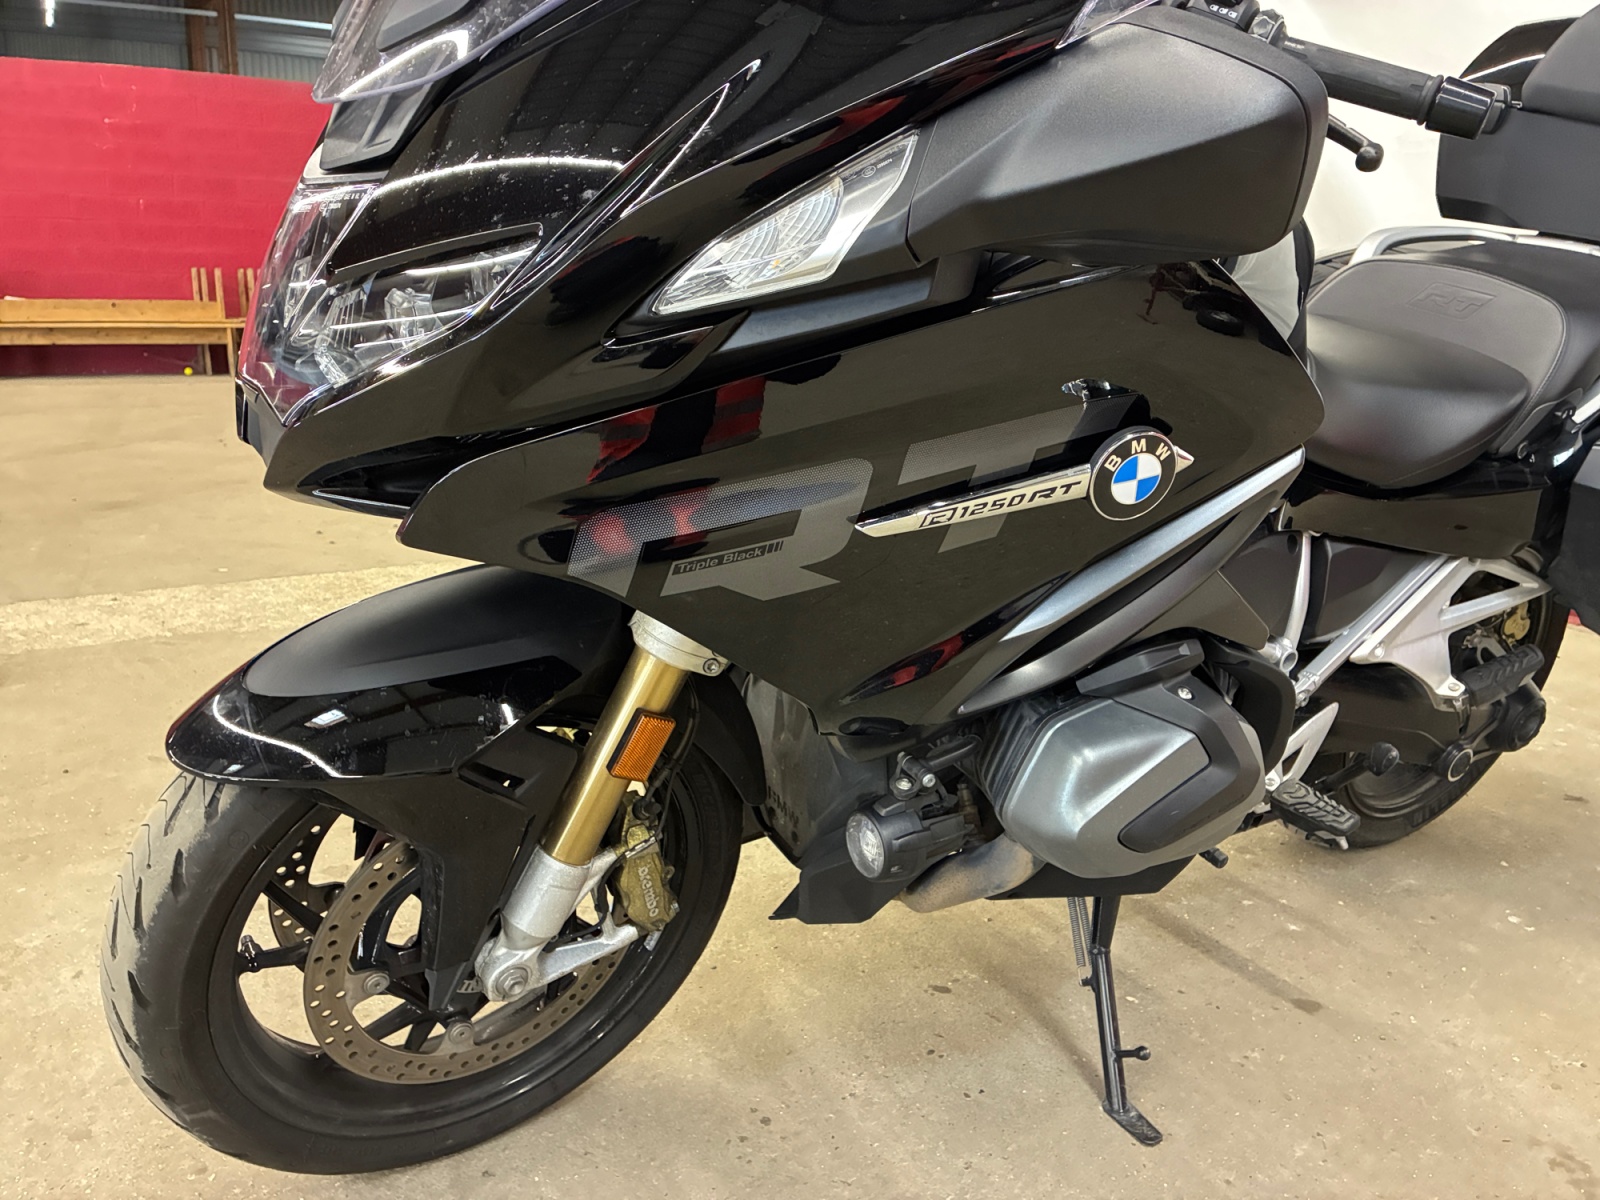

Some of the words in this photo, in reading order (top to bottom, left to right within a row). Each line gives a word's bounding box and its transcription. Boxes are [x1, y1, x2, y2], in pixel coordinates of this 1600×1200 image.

[1412, 289, 1488, 316] RT
[1104, 438, 1171, 472] BMW
[678, 559, 718, 573] Triple
[722, 548, 763, 564] Black
[637, 863, 659, 918] brembo
